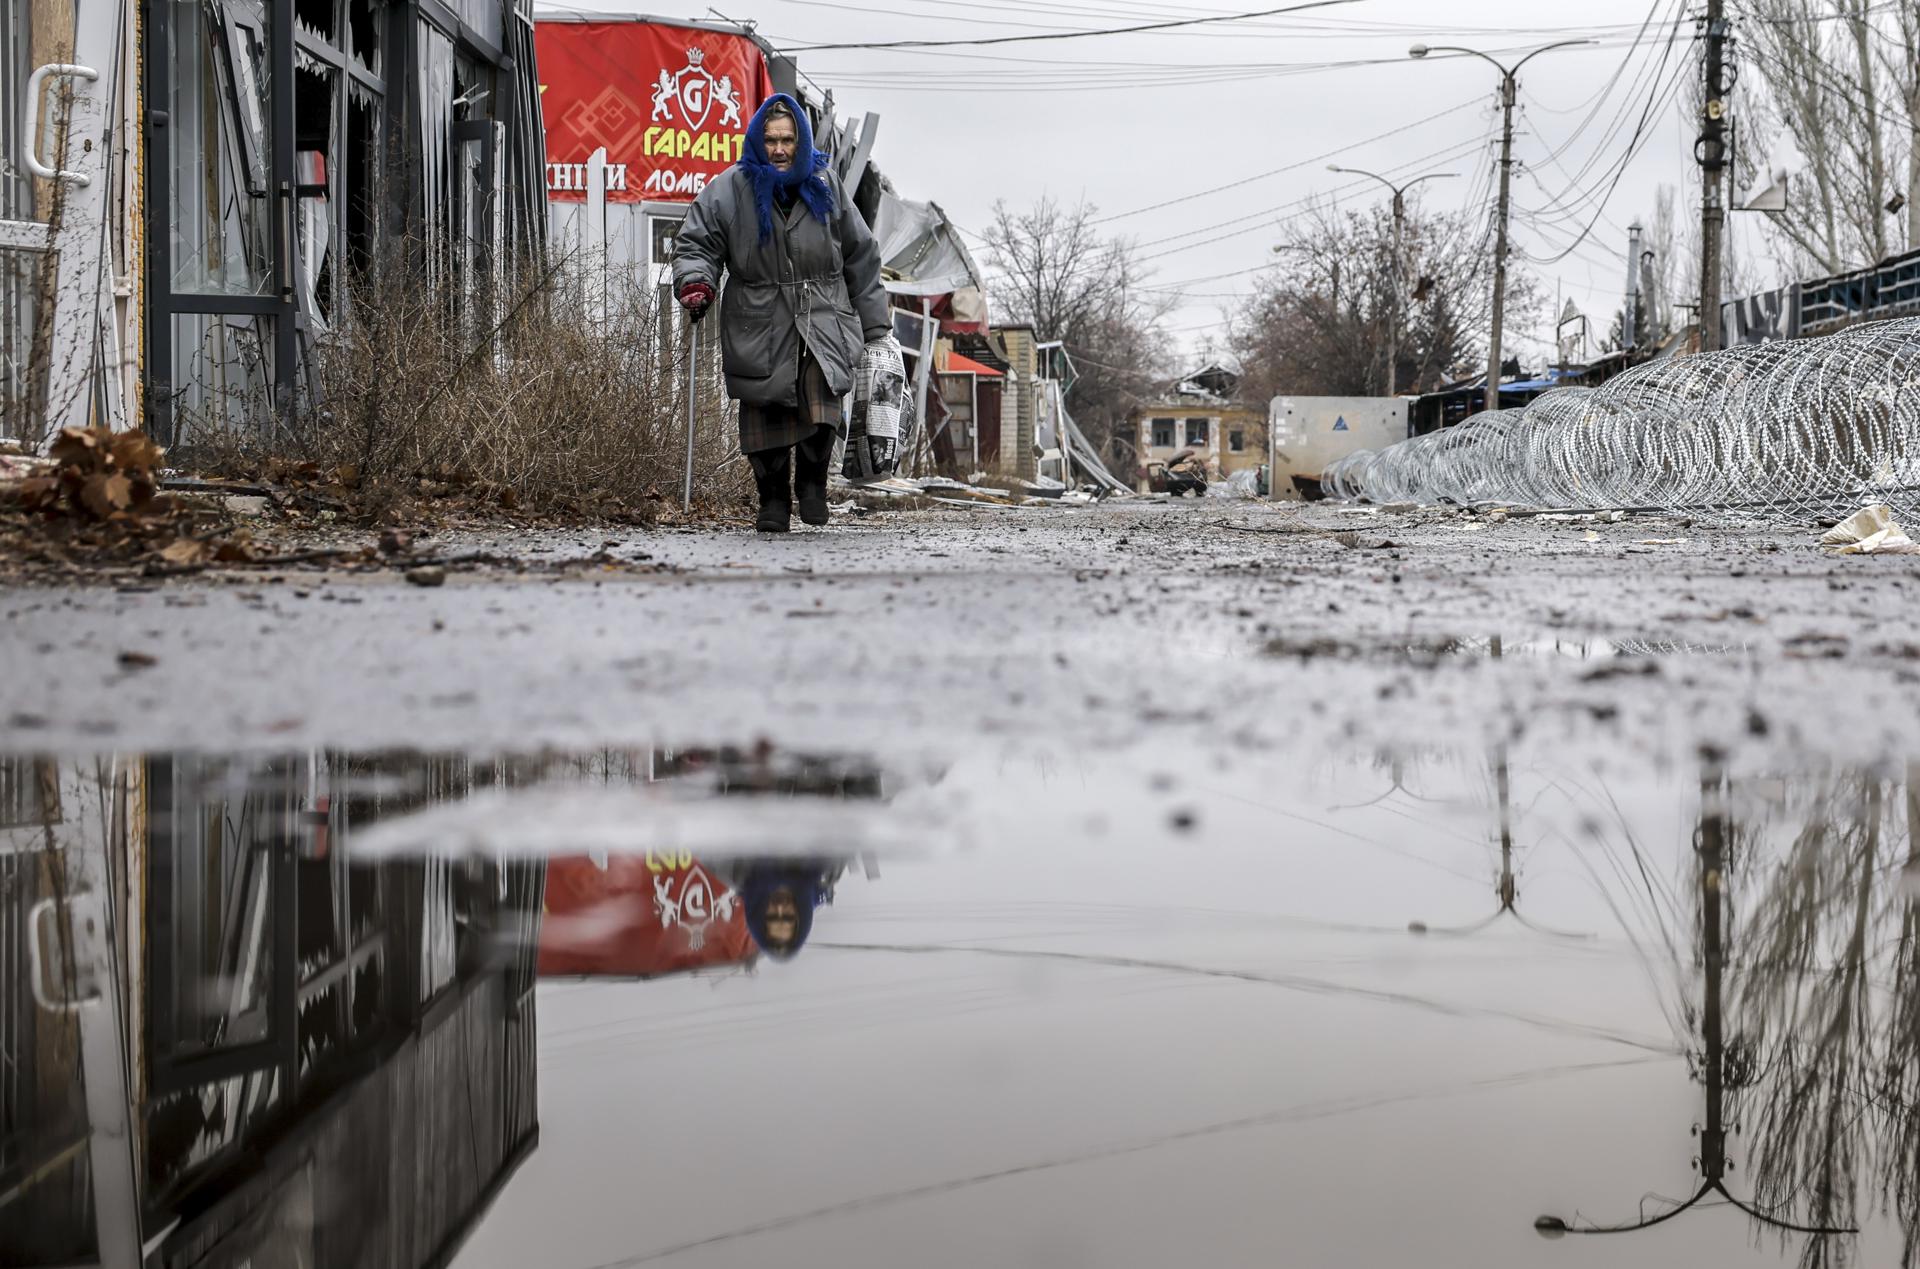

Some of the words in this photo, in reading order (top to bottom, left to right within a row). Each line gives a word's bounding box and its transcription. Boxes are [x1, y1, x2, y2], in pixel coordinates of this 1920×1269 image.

[683, 79, 706, 113] G
[643, 127, 745, 163] ГАРАНТ
[546, 163, 627, 190] НІИ
[644, 169, 720, 194] ЛОМБ
